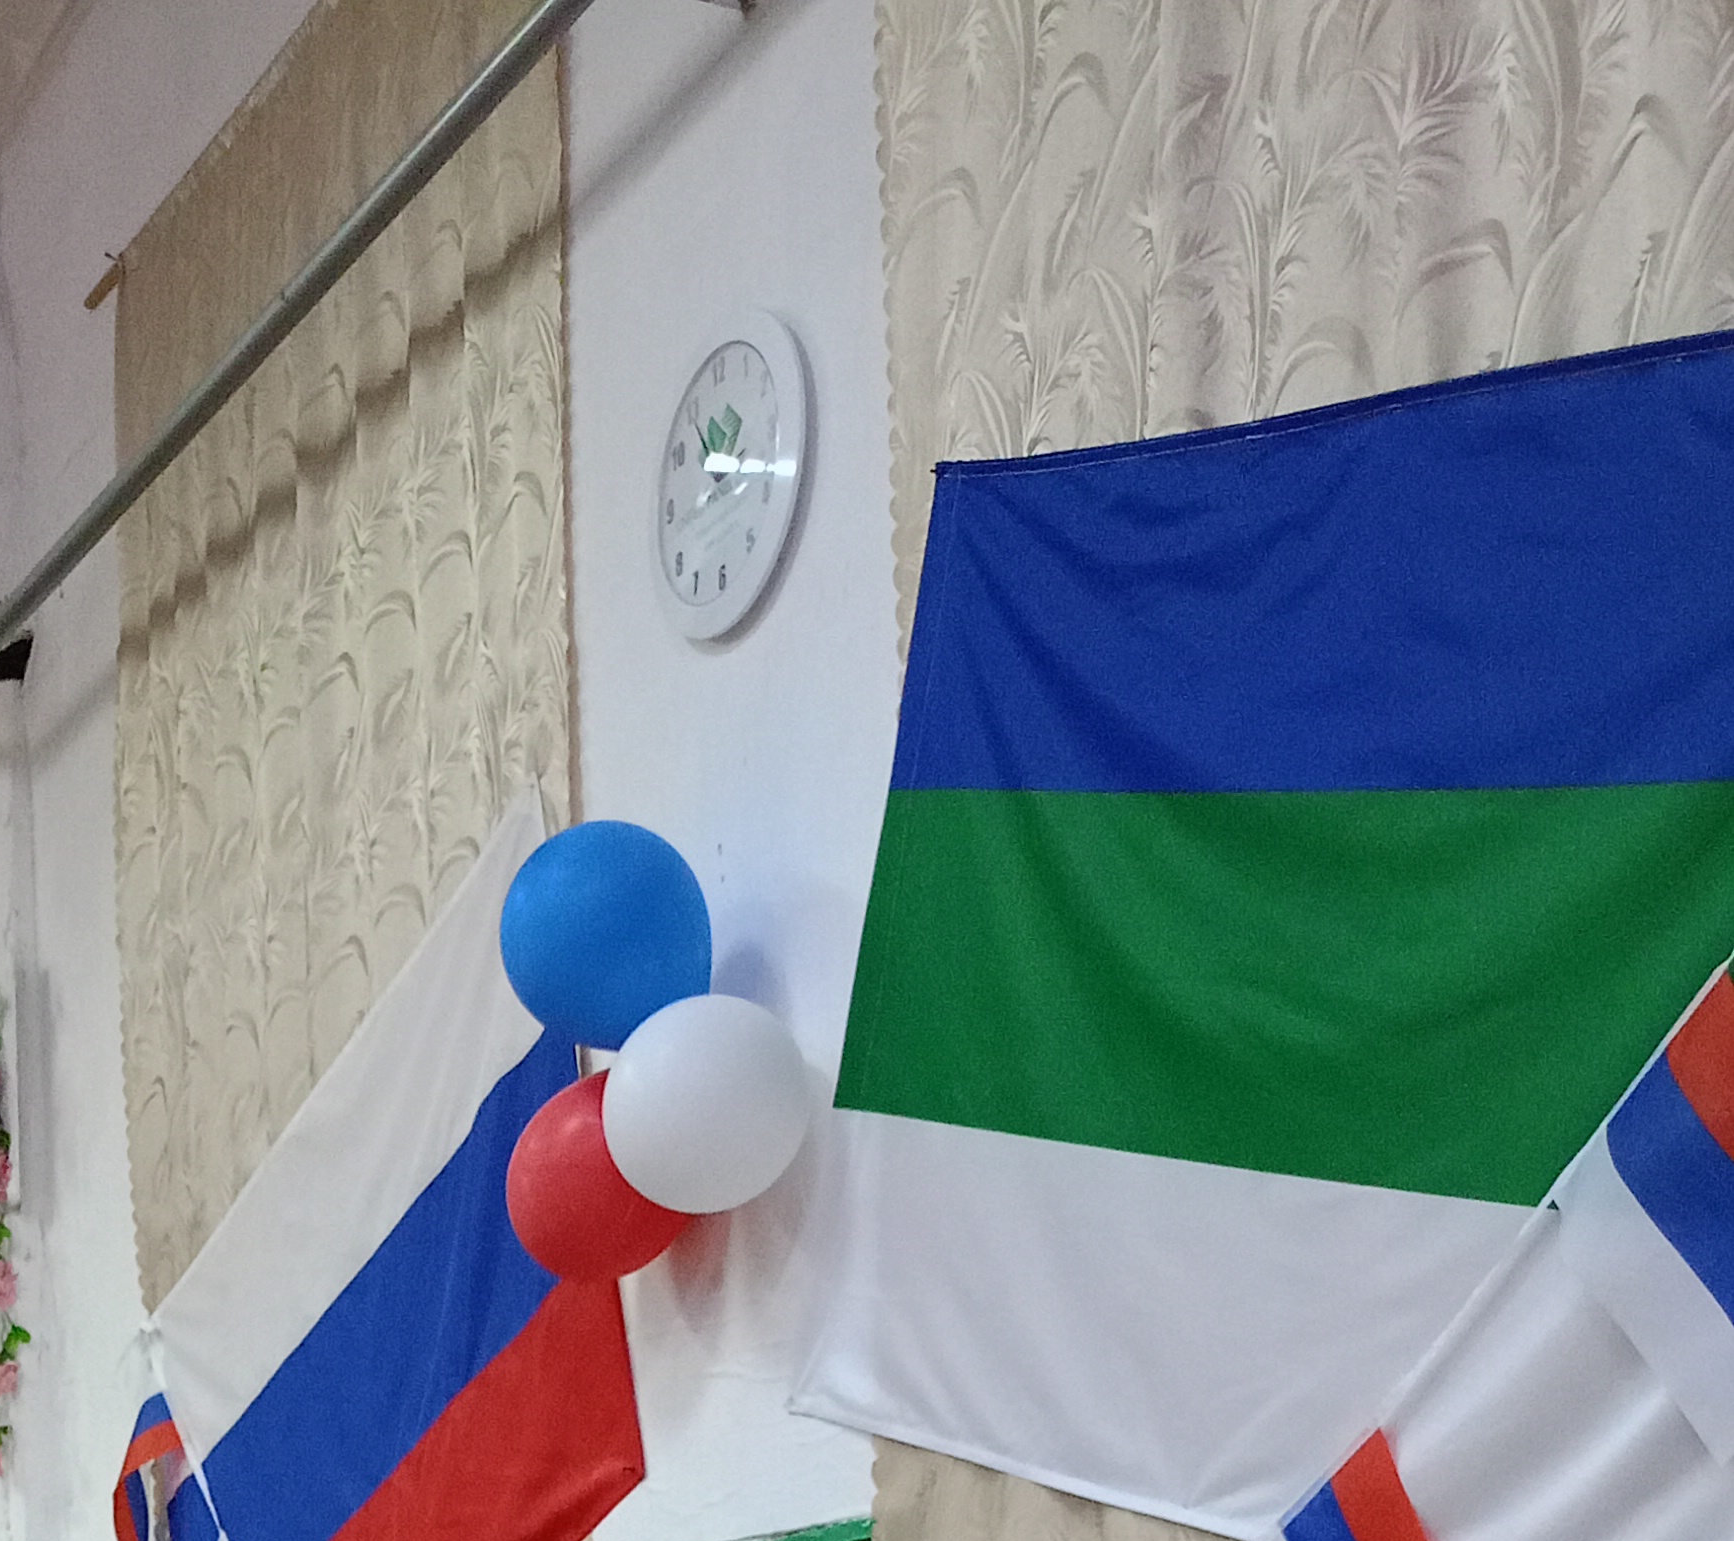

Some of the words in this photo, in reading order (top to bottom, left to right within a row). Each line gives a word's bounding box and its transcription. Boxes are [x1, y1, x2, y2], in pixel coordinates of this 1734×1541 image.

[672, 440, 686, 472] 10
[666, 497, 675, 526] 9
[675, 550, 684, 578] 8
[718, 563, 726, 591] 6
[692, 569, 700, 596] 7
